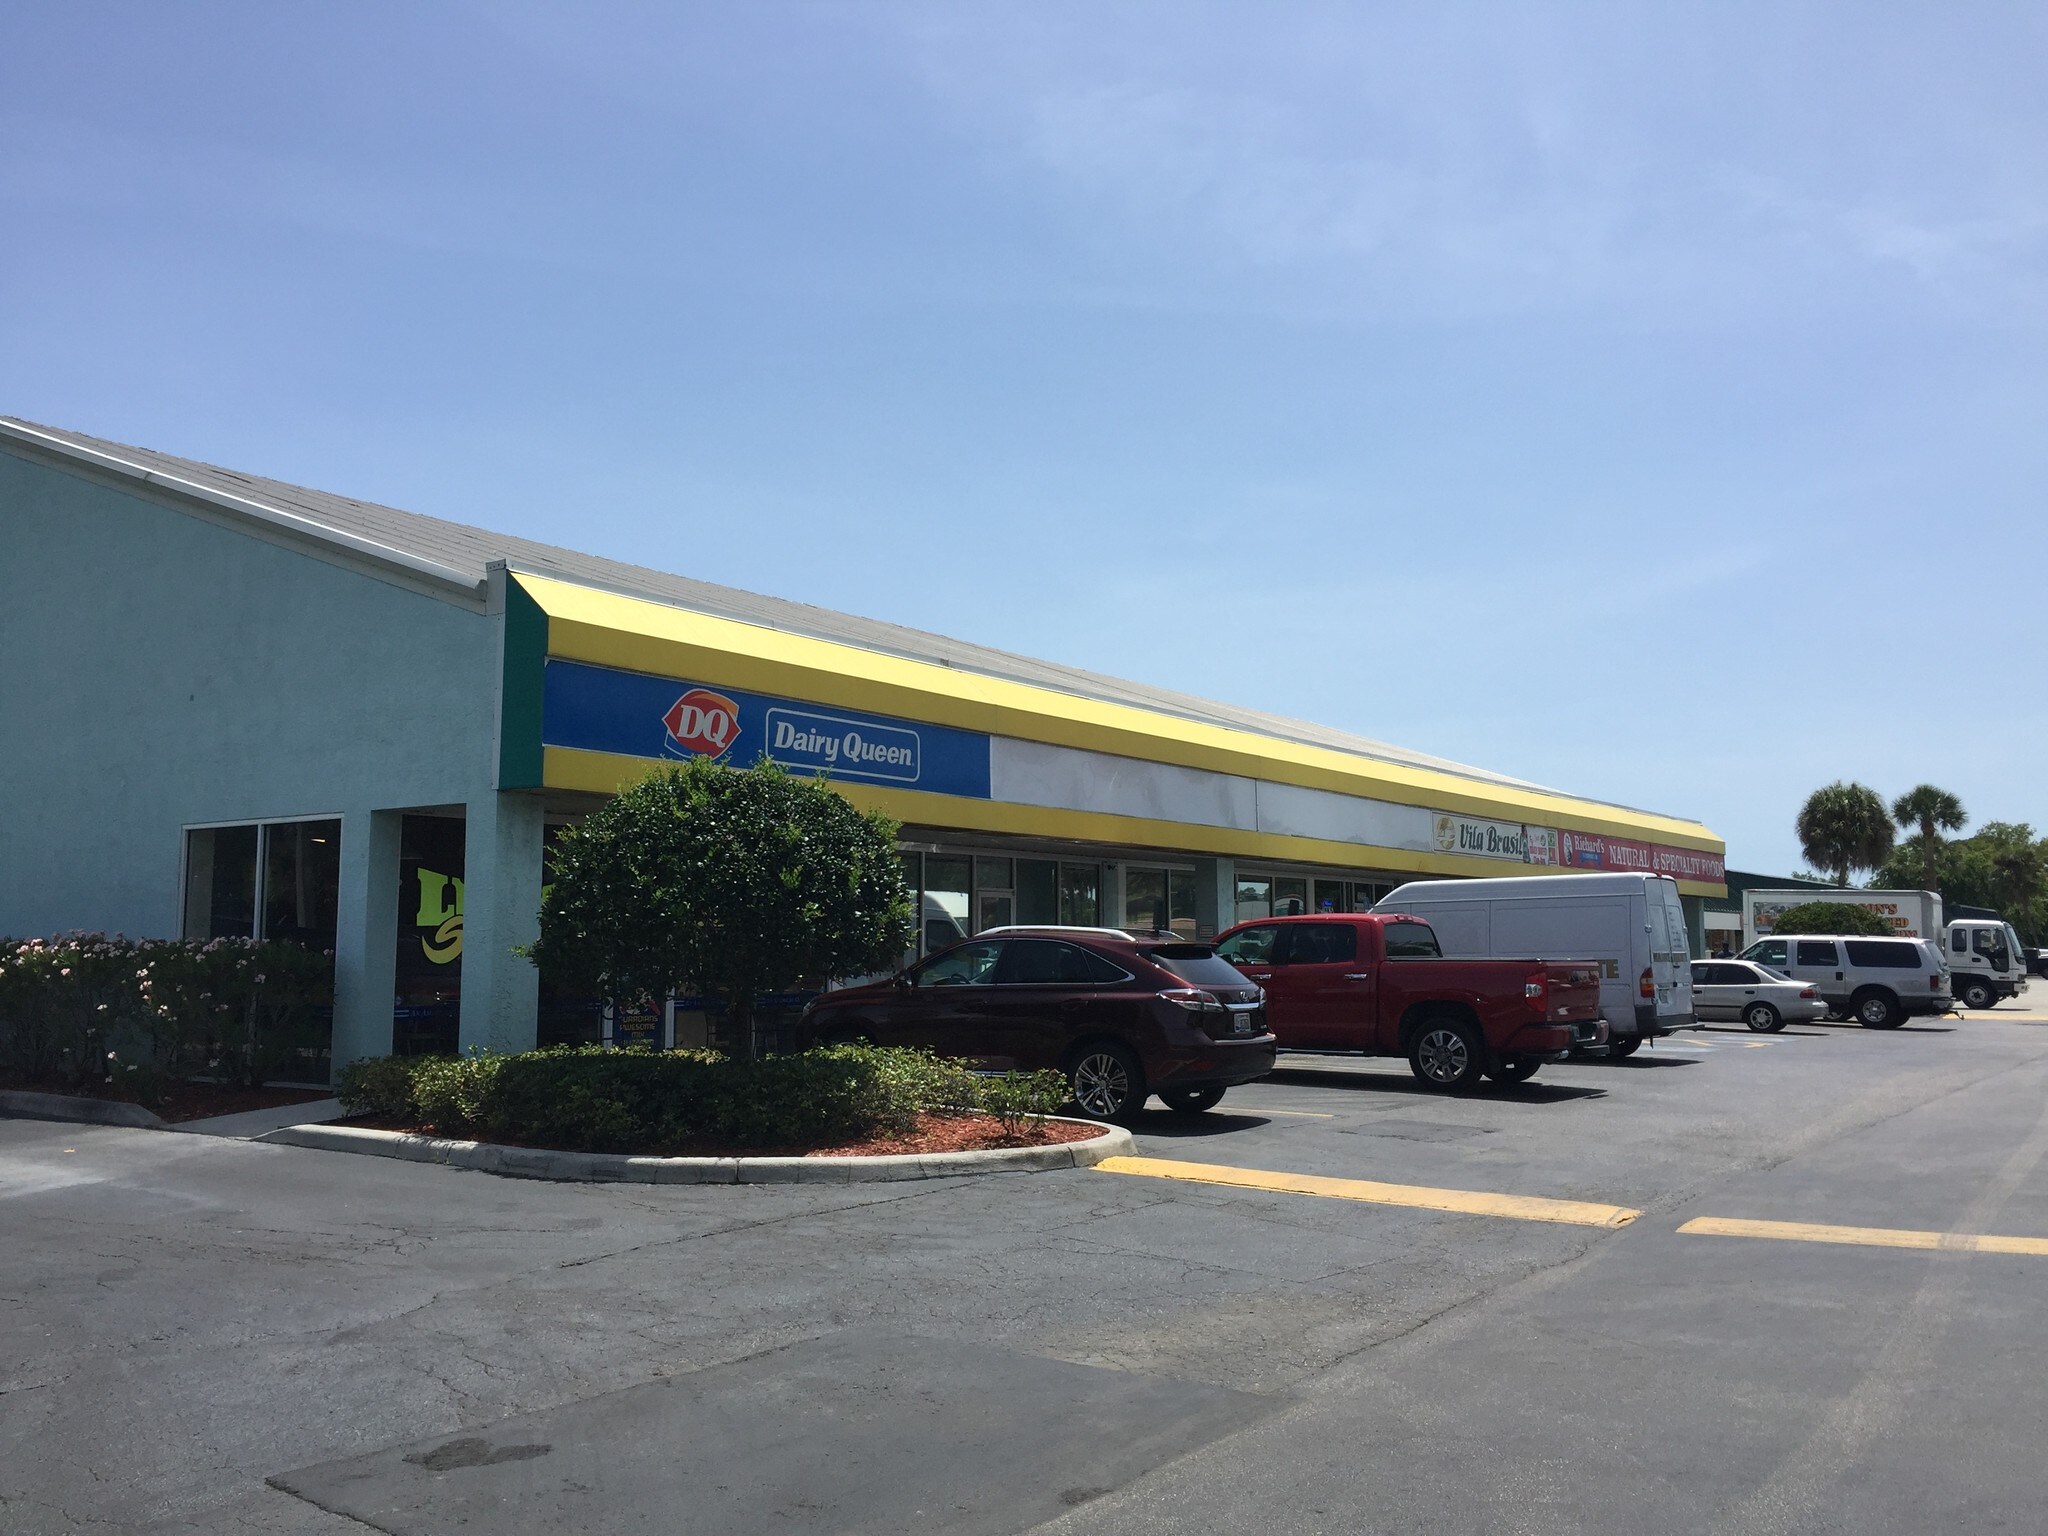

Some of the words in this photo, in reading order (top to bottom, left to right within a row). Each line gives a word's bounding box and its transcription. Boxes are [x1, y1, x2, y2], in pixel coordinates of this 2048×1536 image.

[676, 704, 730, 748] DQ
[774, 720, 840, 762] Dairy
[842, 731, 913, 766] Queen
[1459, 823, 1484, 852] Vila
[1486, 826, 1524, 855] Brasil
[1574, 835, 1605, 853] Richard's
[1608, 845, 1650, 868] NATURAL
[1652, 851, 1660, 870] &
[1660, 853, 1701, 875] SPECIALTY
[1702, 859, 1725, 878] FOODS
